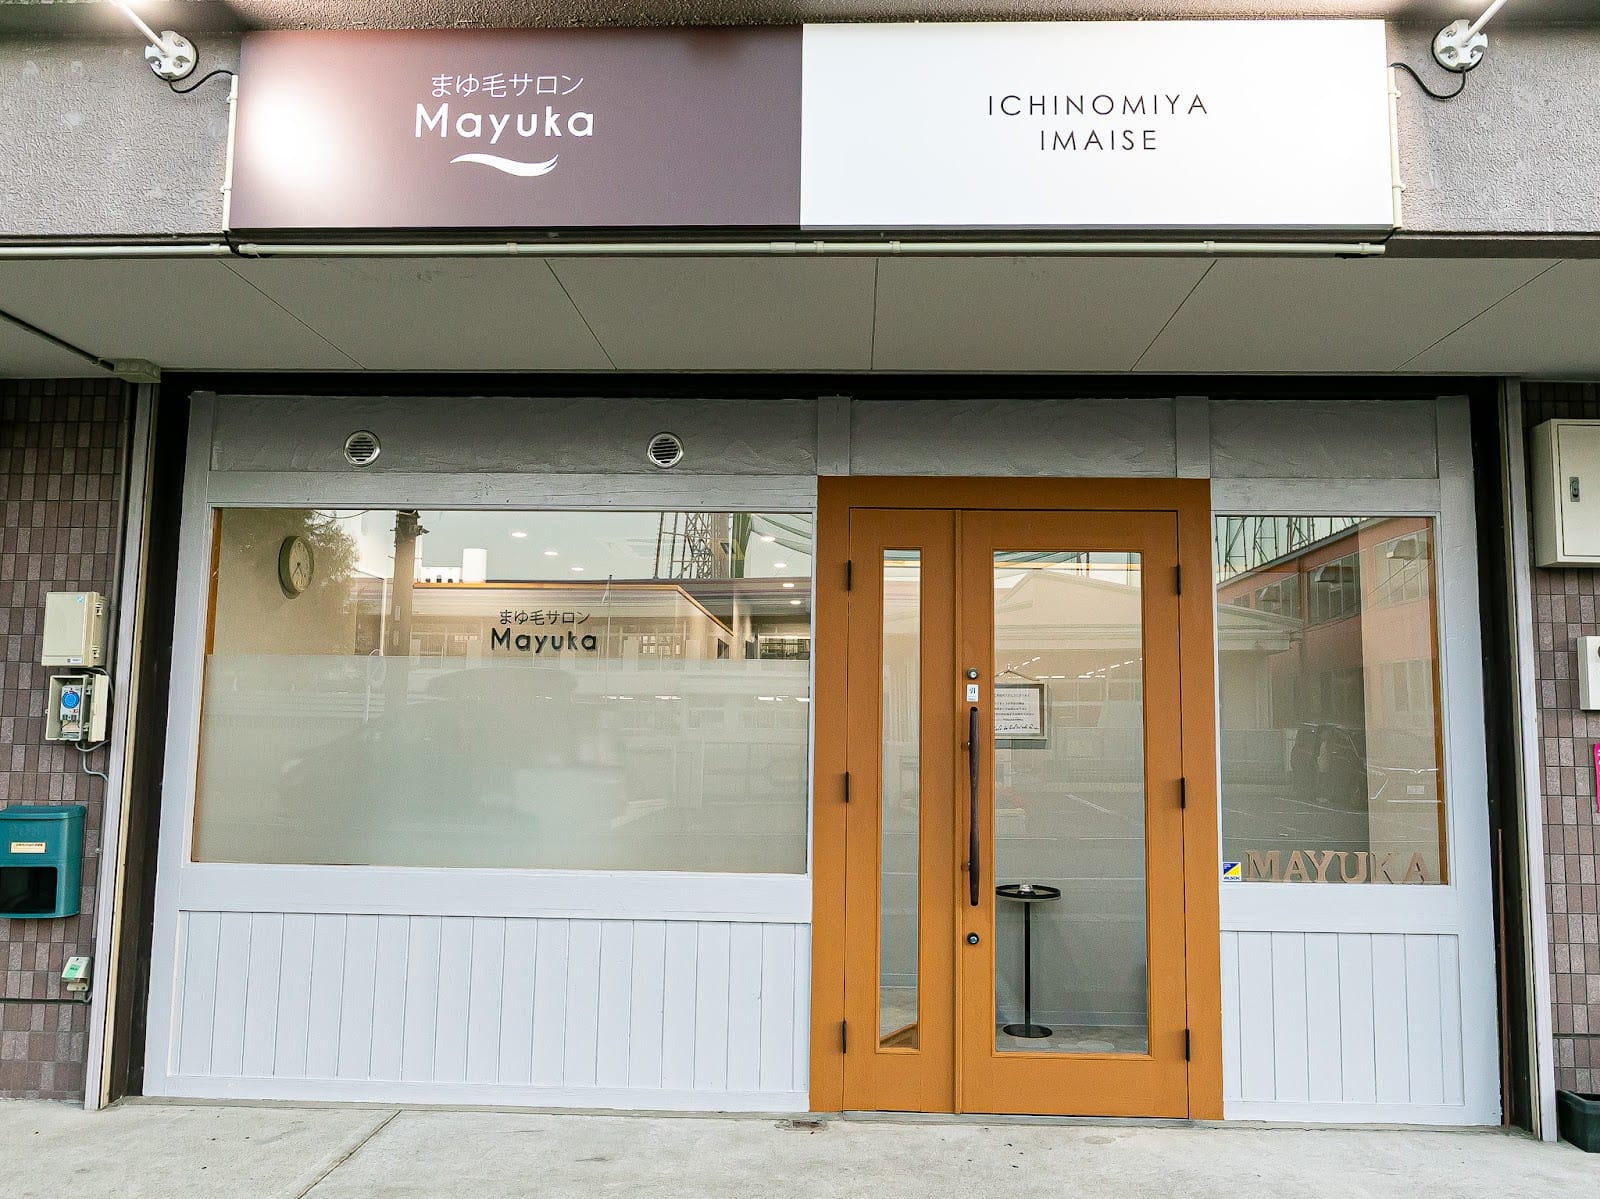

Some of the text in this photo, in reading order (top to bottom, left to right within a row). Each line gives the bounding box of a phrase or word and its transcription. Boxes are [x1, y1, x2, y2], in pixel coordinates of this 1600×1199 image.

[431, 72, 584, 98] まゆ毛サロン
[988, 94, 1208, 116] ICHINOMIYA
[415, 102, 594, 145] Mayuka
[1040, 129, 1157, 151] IMAISE
[499, 609, 591, 626] まゆ毛サロン
[491, 627, 597, 653] Mayuka
[1246, 849, 1431, 885] MAYUKA
